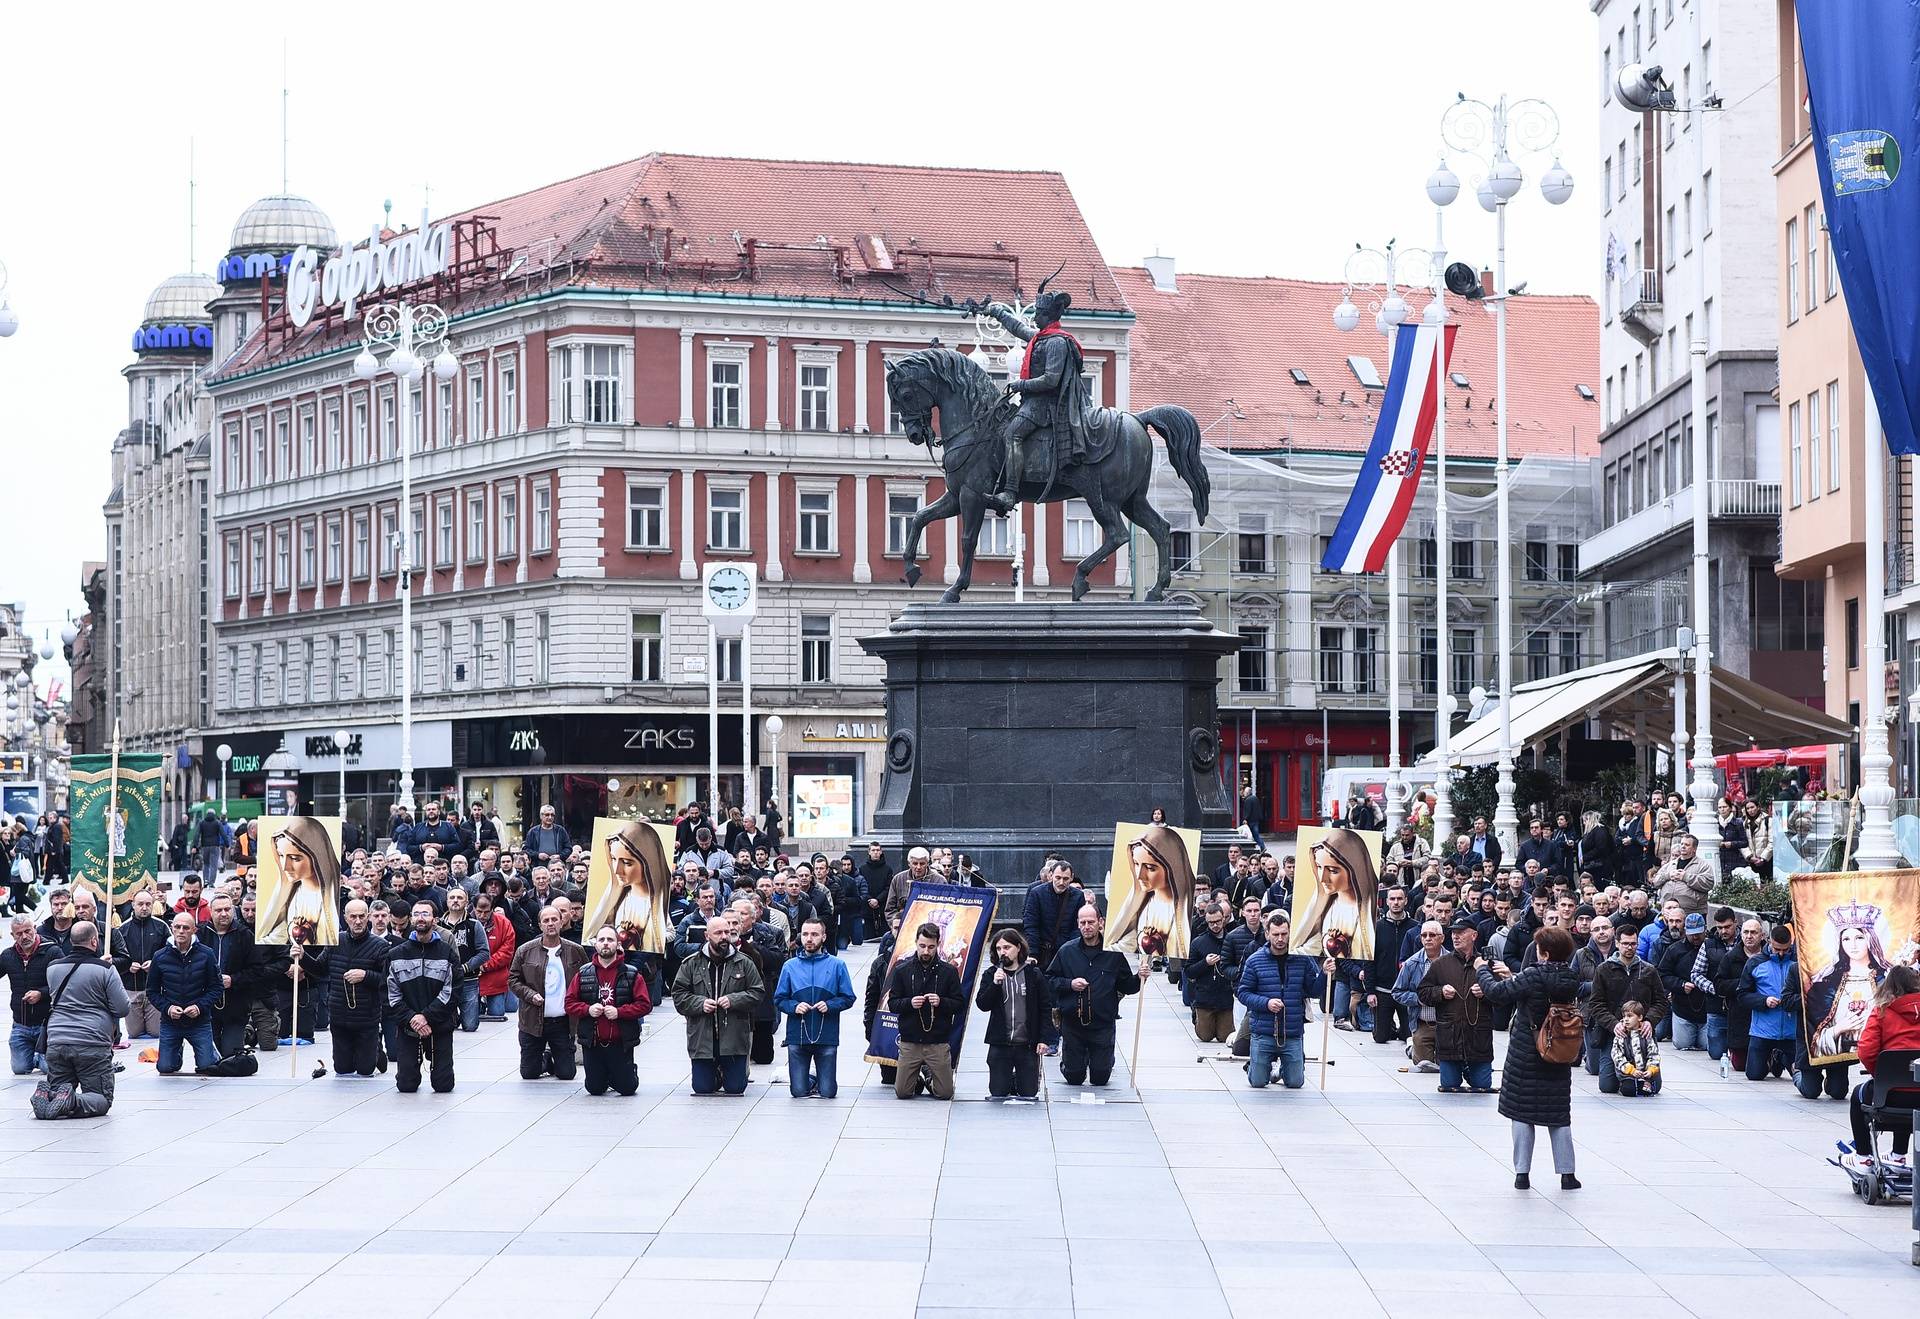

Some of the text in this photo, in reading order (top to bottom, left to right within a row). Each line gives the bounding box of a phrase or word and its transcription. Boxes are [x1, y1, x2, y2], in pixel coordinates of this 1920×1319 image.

[132, 324, 213, 350] nama
[624, 728, 695, 749] ZAKS
[232, 755, 260, 772] DOUGLAS
[76, 798, 92, 819] Sveti
[85, 849, 104, 866] brani
